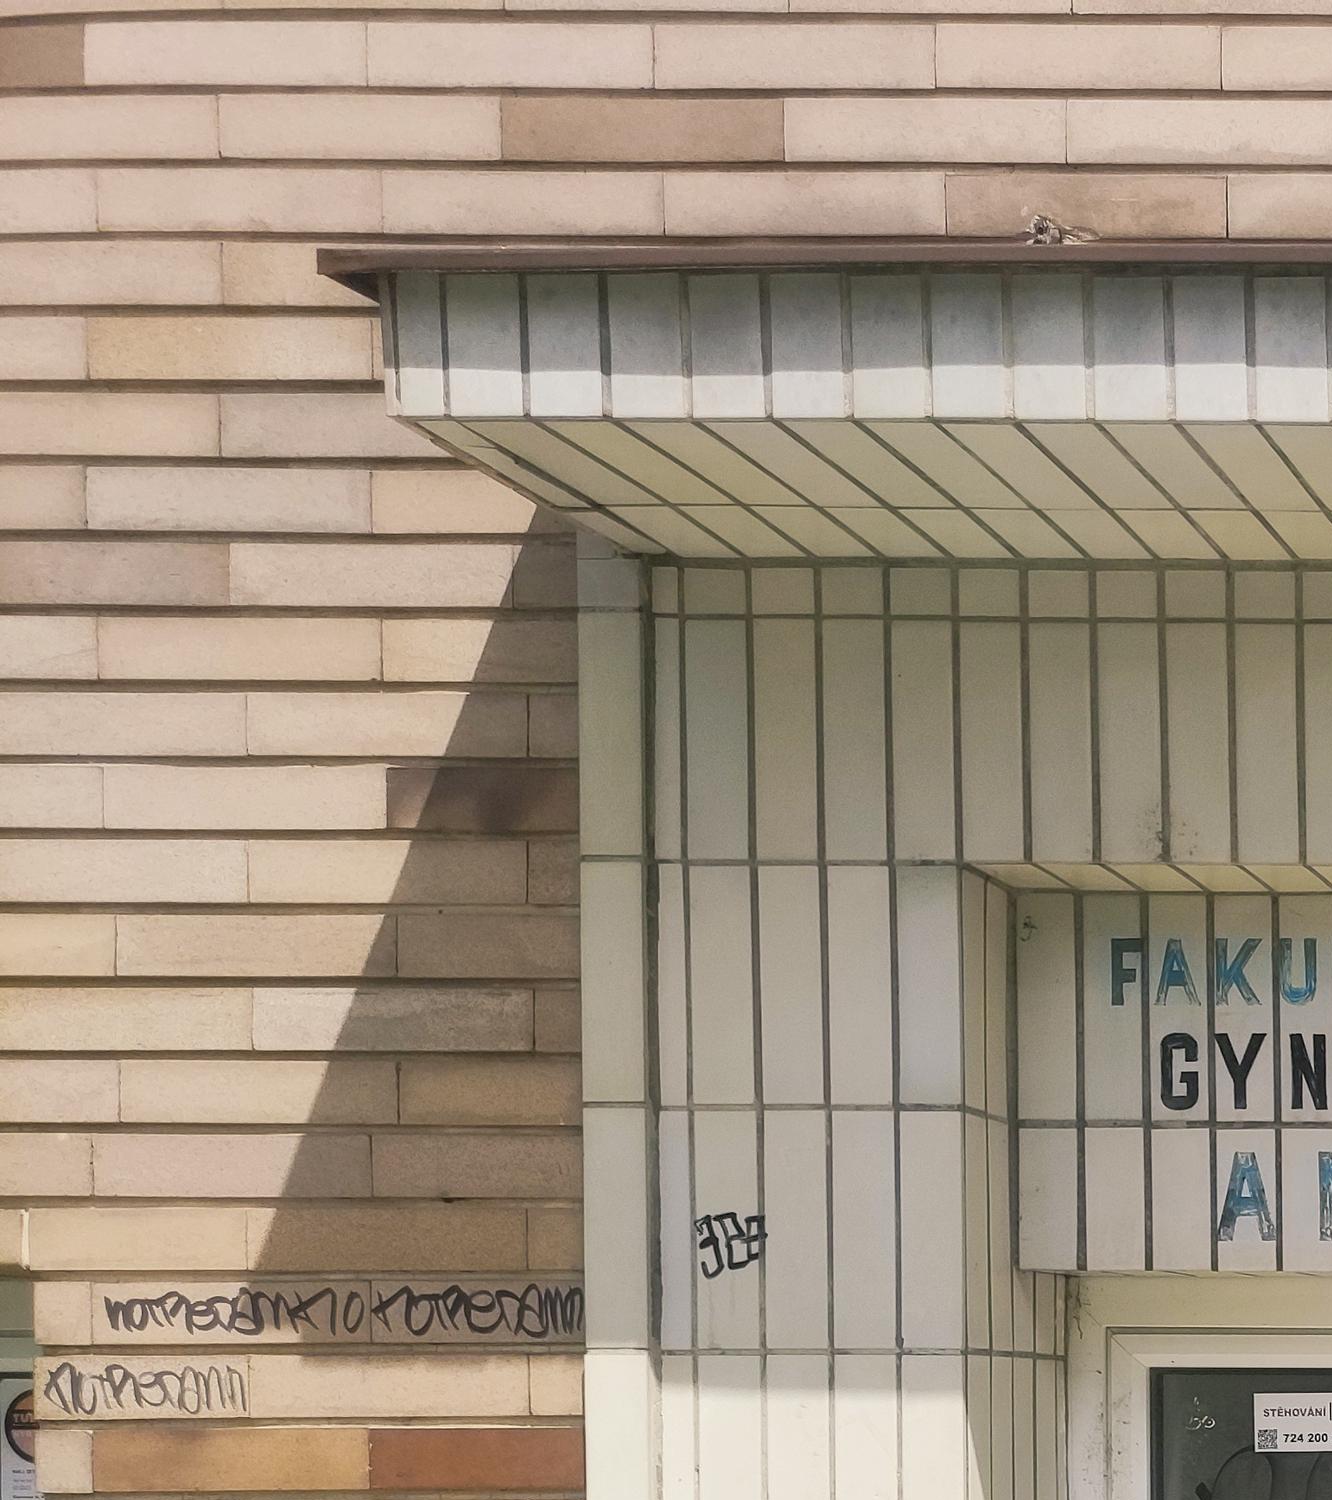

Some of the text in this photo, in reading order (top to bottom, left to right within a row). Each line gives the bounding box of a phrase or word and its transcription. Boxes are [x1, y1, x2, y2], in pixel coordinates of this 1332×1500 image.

[1263, 1406, 1327, 1418] STĚHOVÁNÍ
[1282, 1433, 1304, 1443] 724
[1308, 1433, 1329, 1443] 200
